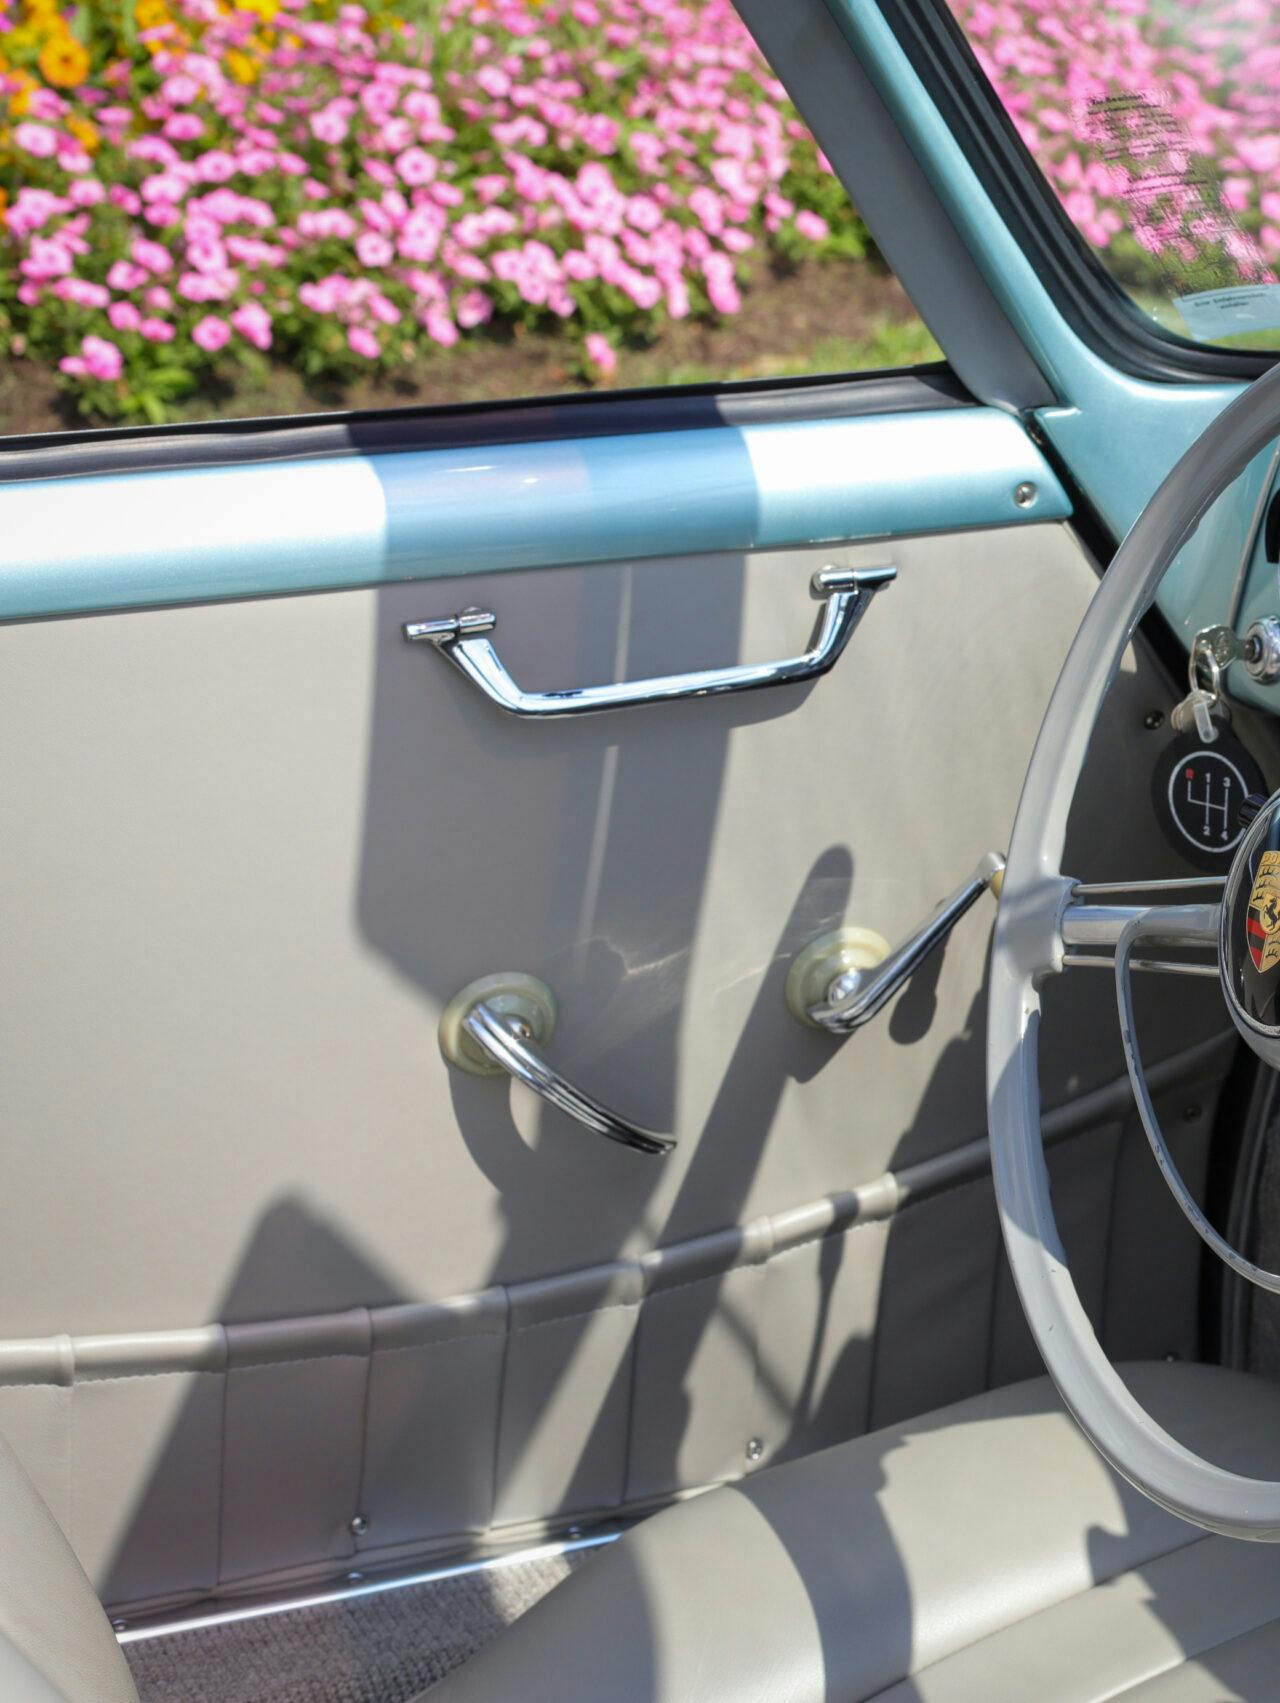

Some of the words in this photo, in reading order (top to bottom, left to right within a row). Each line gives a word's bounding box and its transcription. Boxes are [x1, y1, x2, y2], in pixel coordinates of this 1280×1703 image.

[1205, 772, 1211, 783] 1
[1222, 776, 1231, 788] 3
[1203, 825, 1211, 836] 2
